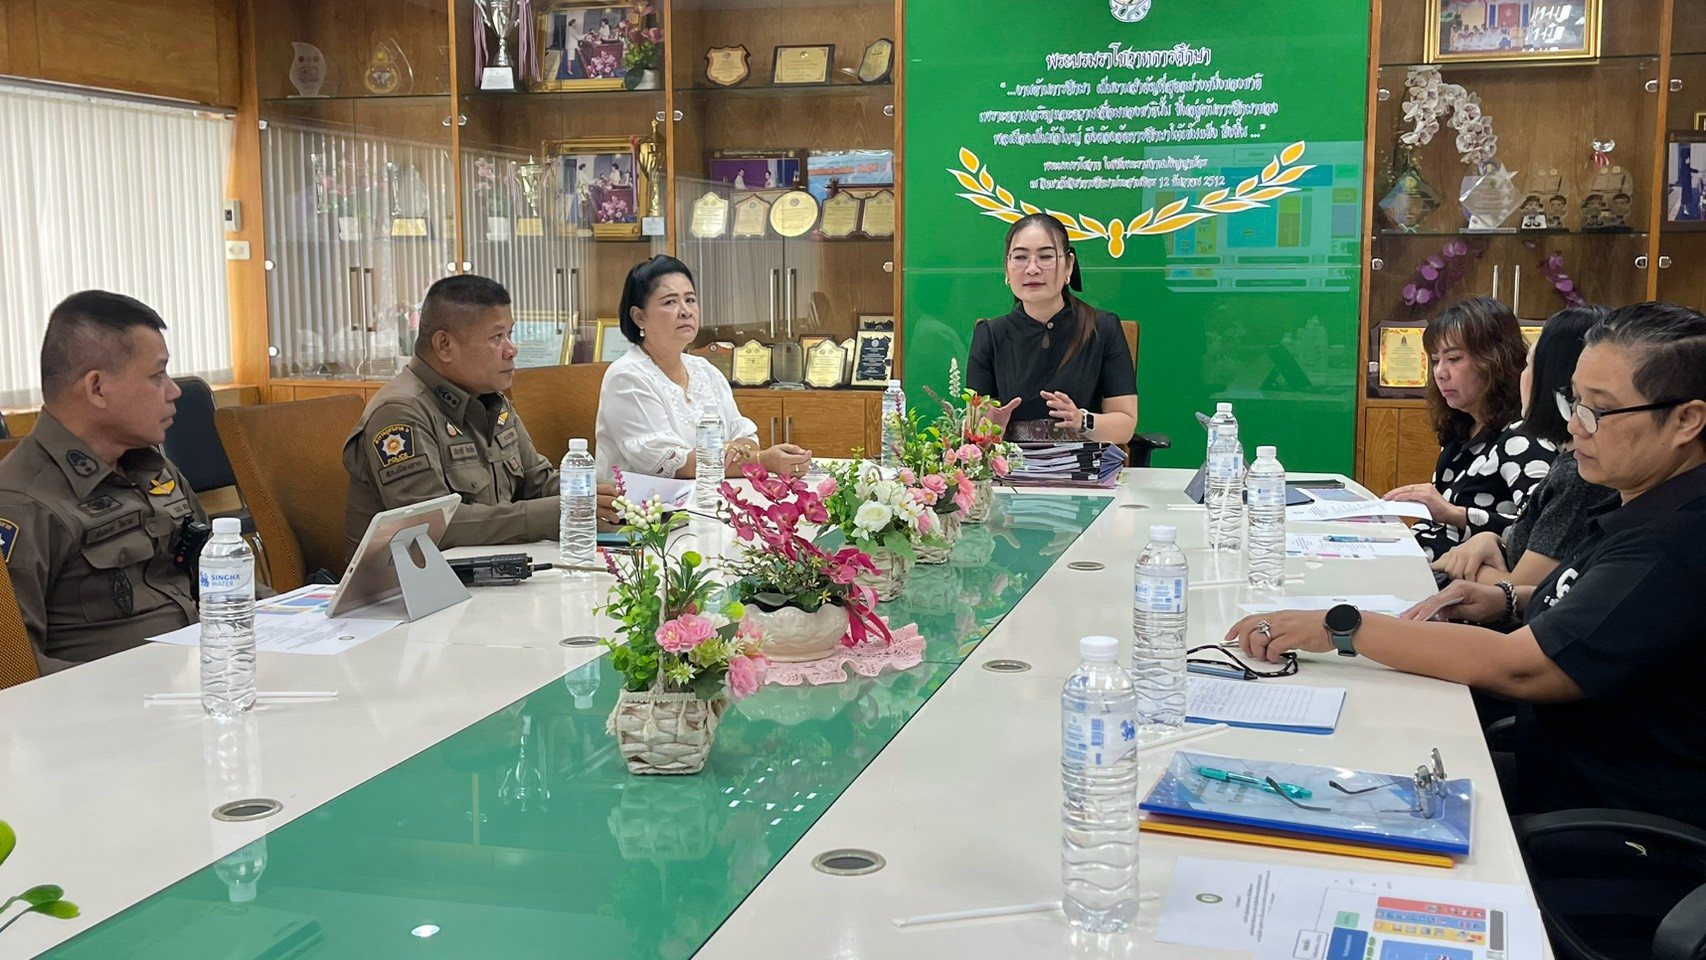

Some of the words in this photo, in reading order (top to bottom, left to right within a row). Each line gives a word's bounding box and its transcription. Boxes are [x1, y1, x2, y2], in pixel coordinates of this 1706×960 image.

[1046, 42, 1212, 70] พระบรมราโชวาทการศึกษา
[1158, 176, 1170, 188] 12
[1203, 175, 1226, 188] 2512
